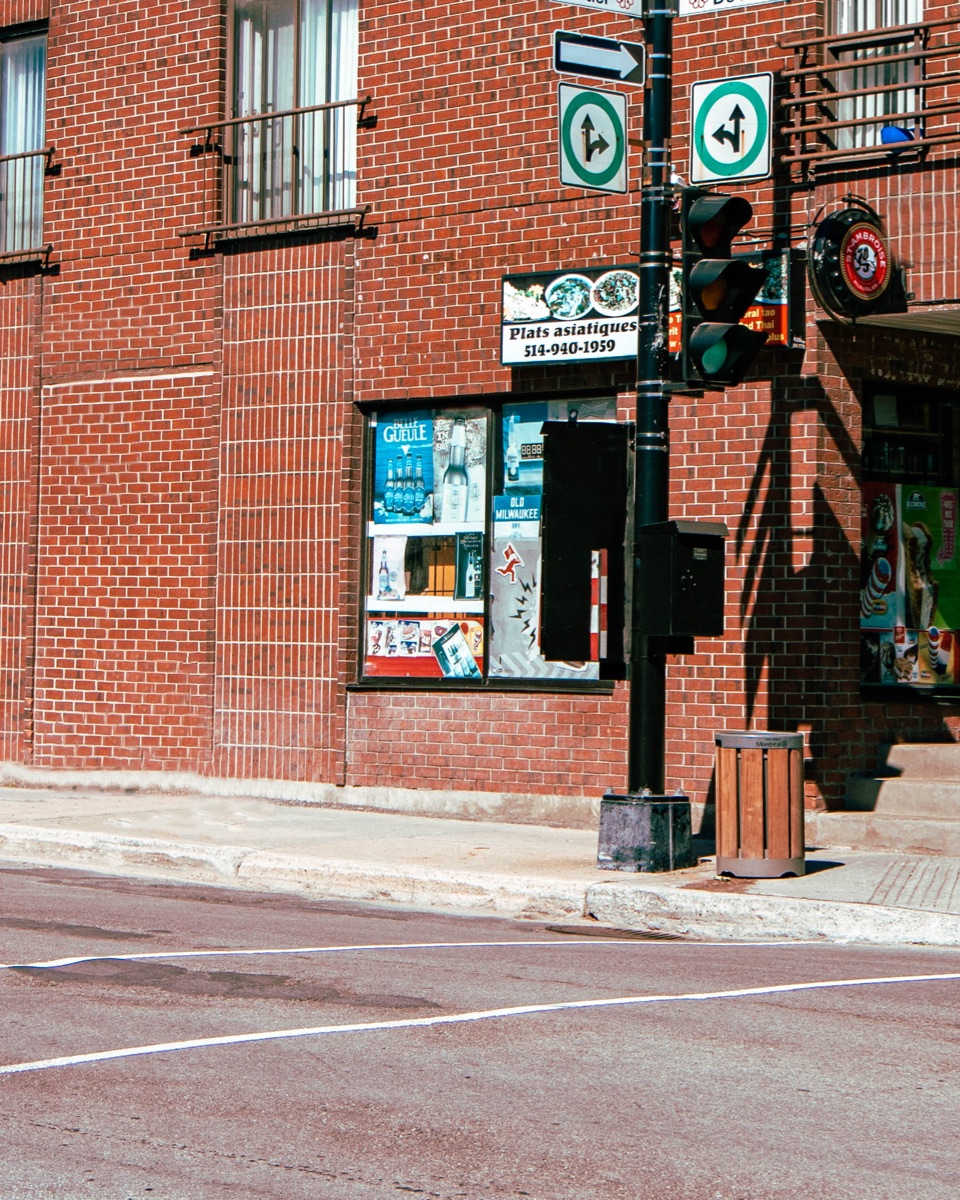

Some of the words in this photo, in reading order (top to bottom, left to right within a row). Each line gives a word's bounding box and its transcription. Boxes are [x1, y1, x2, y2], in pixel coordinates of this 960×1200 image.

[761, 309, 776, 317] tao
[509, 326, 550, 341] Plats
[553, 321, 637, 338] asiatiques
[755, 320, 775, 330] Thai
[524, 339, 616, 358] 514-940-1959
[393, 417, 418, 430] BELLE
[383, 424, 428, 443] GUEULE
[510, 496, 525, 508] OLD
[496, 508, 539, 520] MILWAUKEE
